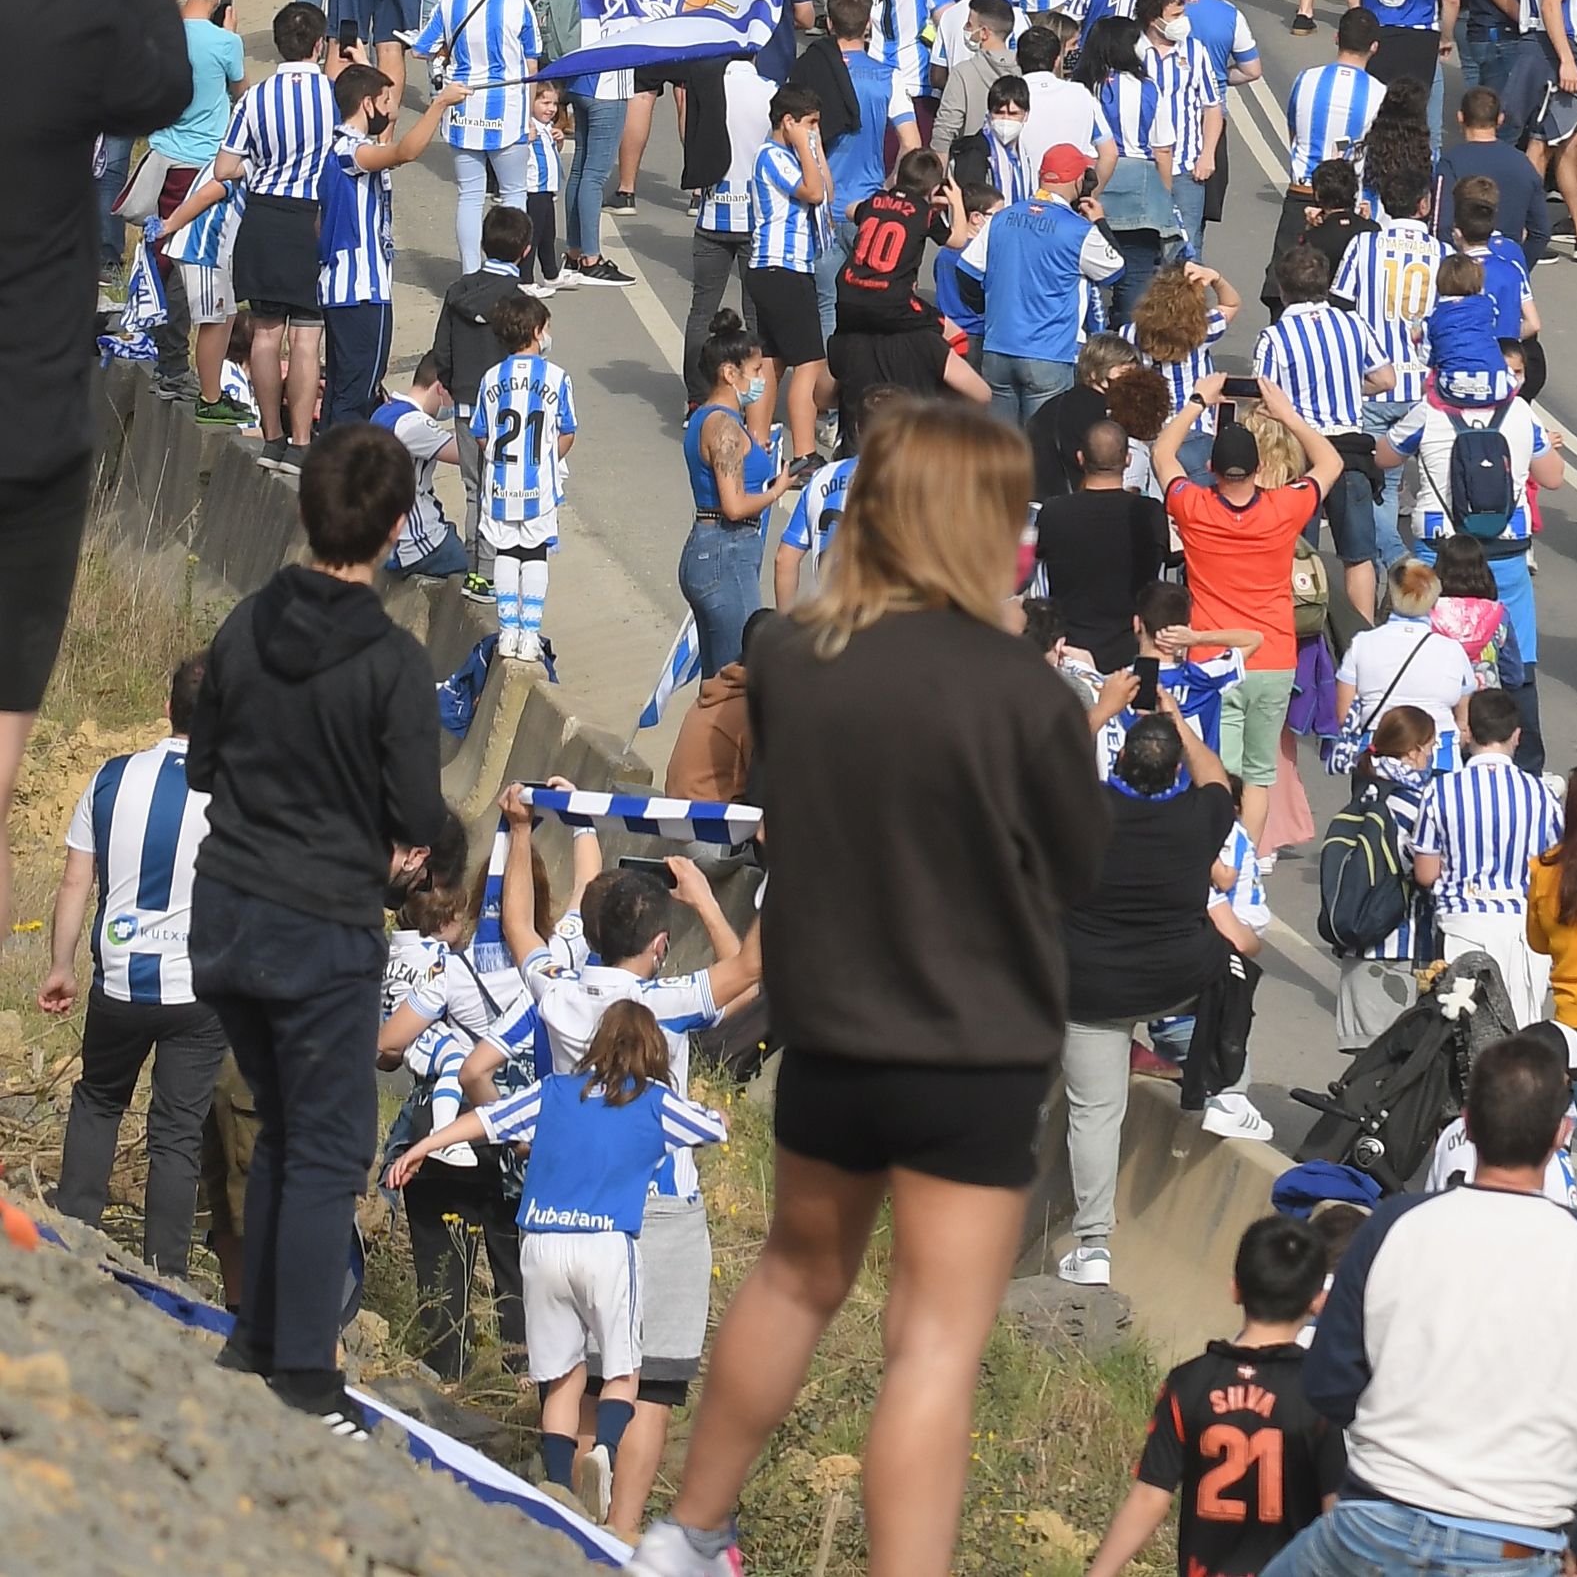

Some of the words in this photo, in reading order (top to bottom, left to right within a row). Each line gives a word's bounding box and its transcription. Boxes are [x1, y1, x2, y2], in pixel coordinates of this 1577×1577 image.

[450, 106, 503, 129] Kutxabank
[854, 215, 908, 274] 10
[1377, 236, 1439, 257] OYARZABAL
[1383, 259, 1431, 322] 10
[486, 376, 559, 405] ODEGAARD
[494, 408, 546, 467] 21
[491, 481, 540, 500] Kutxabank
[1208, 1383, 1277, 1419] SILVA
[1196, 1422, 1284, 1523] 21
